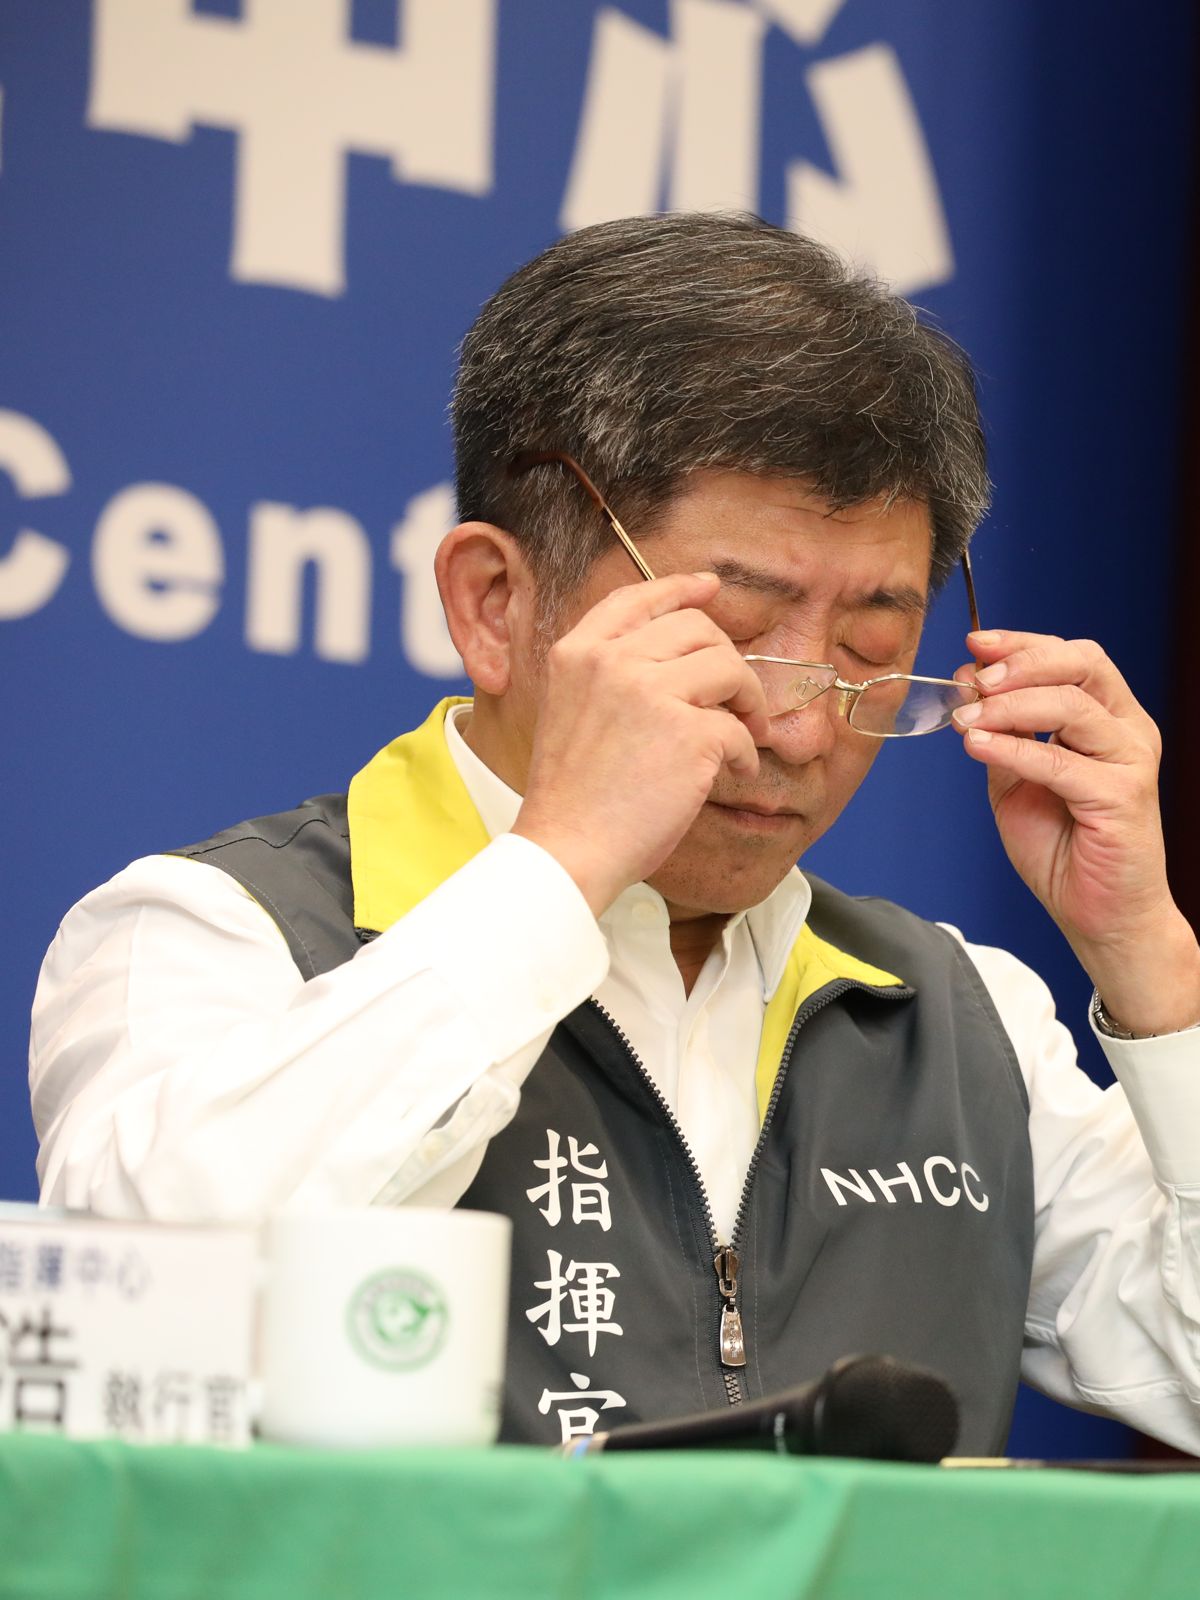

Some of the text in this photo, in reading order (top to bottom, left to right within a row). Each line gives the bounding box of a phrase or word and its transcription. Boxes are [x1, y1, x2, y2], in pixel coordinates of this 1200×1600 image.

[820, 1155, 990, 1212] NHCC
[525, 1128, 628, 1444] 指揮官
